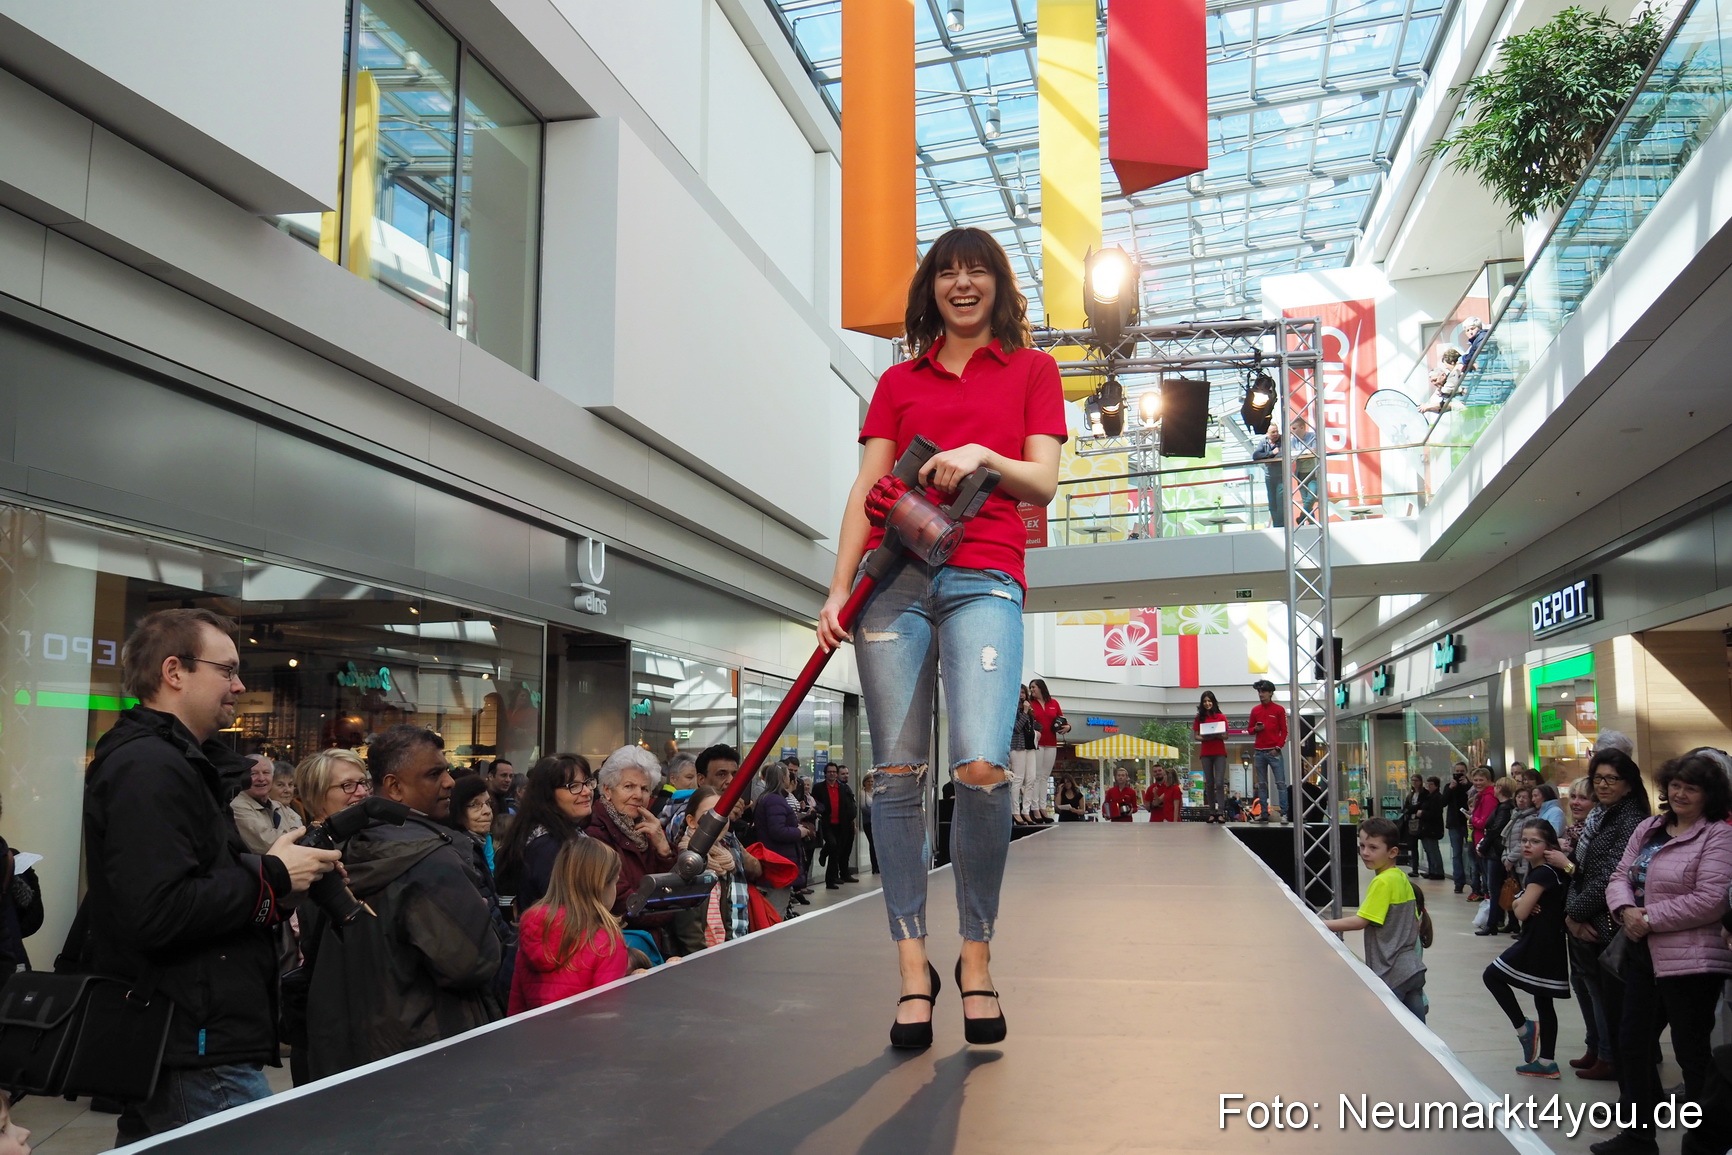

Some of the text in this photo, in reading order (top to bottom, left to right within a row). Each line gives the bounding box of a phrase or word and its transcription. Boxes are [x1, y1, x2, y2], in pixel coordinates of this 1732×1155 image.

[580, 591, 607, 615] eins
[1531, 580, 1586, 631] DEPOT
[255, 898, 270, 923] EOS
